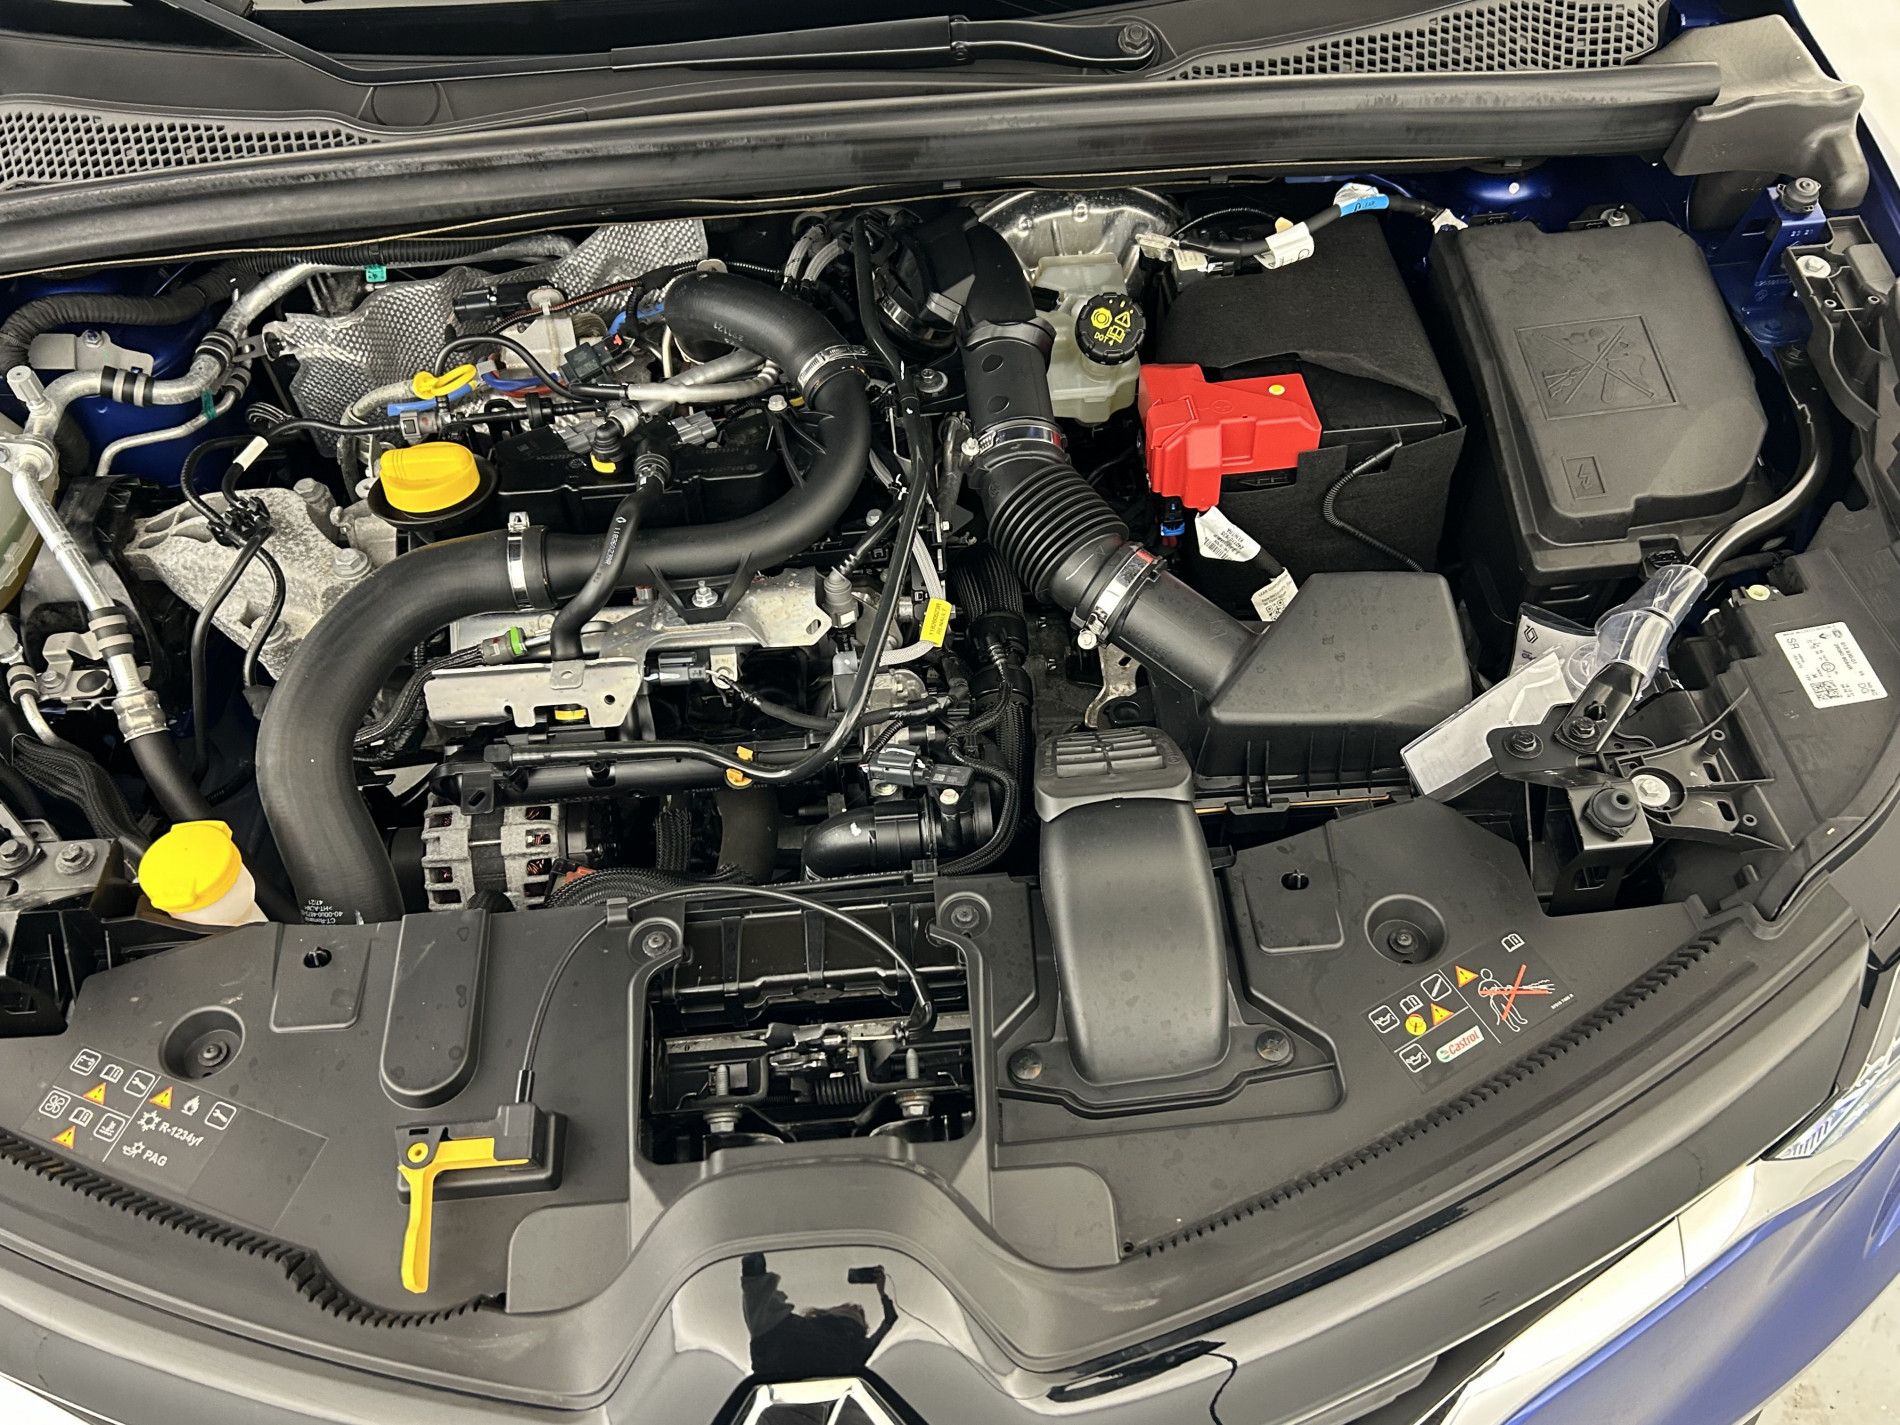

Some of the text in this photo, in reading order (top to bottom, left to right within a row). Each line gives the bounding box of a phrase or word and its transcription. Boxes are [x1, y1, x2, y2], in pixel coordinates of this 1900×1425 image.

[1094, 332, 1109, 343] DOT
[936, 608, 946, 634] RENAULT
[1448, 1030, 1480, 1055] Castrol
[159, 1122, 204, 1147] R-1234yf
[143, 1149, 167, 1167] PAG
